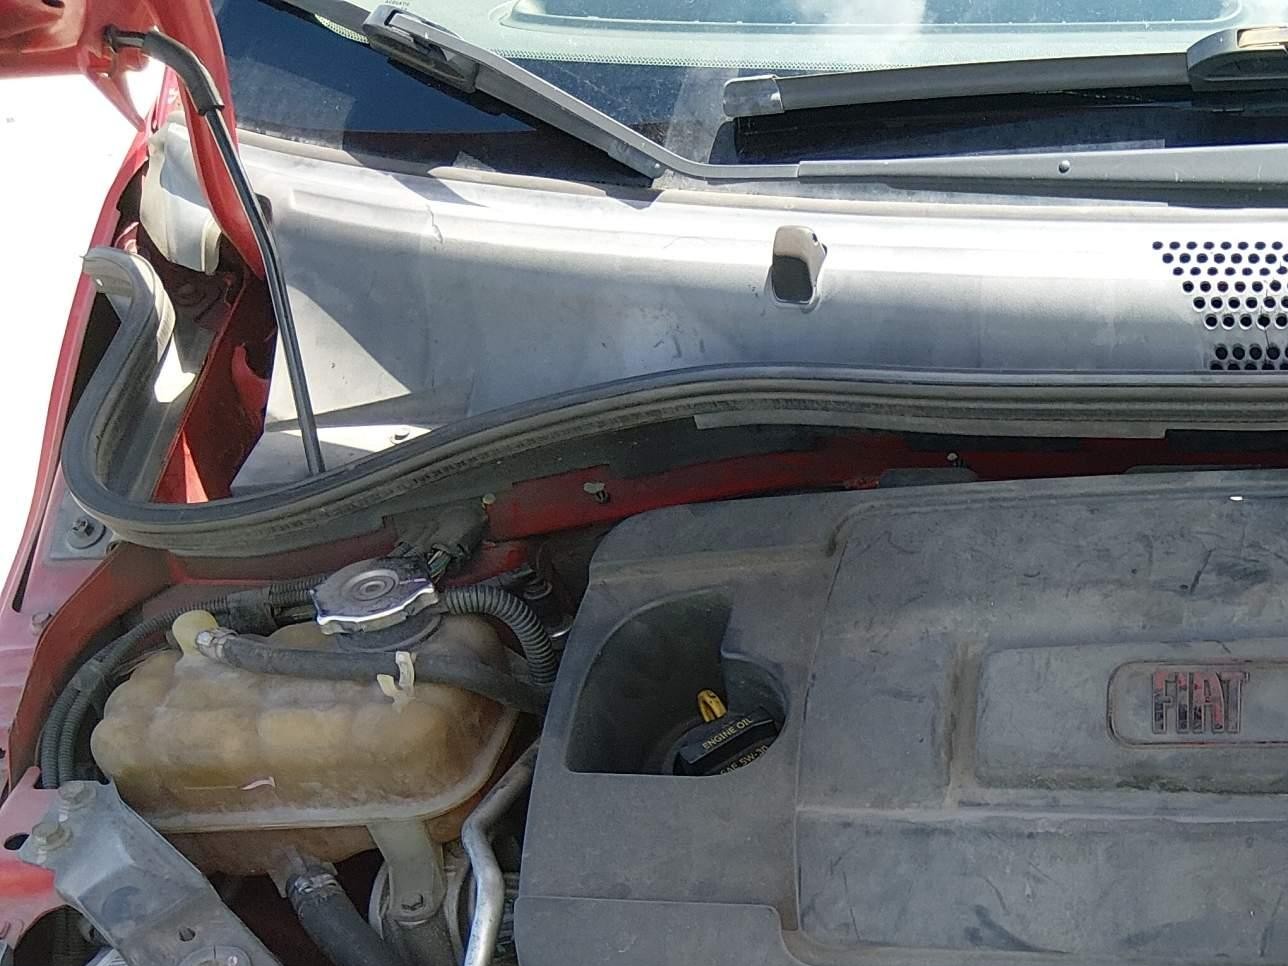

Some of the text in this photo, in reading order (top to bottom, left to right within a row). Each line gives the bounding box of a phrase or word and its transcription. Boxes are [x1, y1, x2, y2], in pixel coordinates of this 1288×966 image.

[1152, 671, 1251, 734] FIAT
[702, 717, 753, 750] ENGINE OIL
